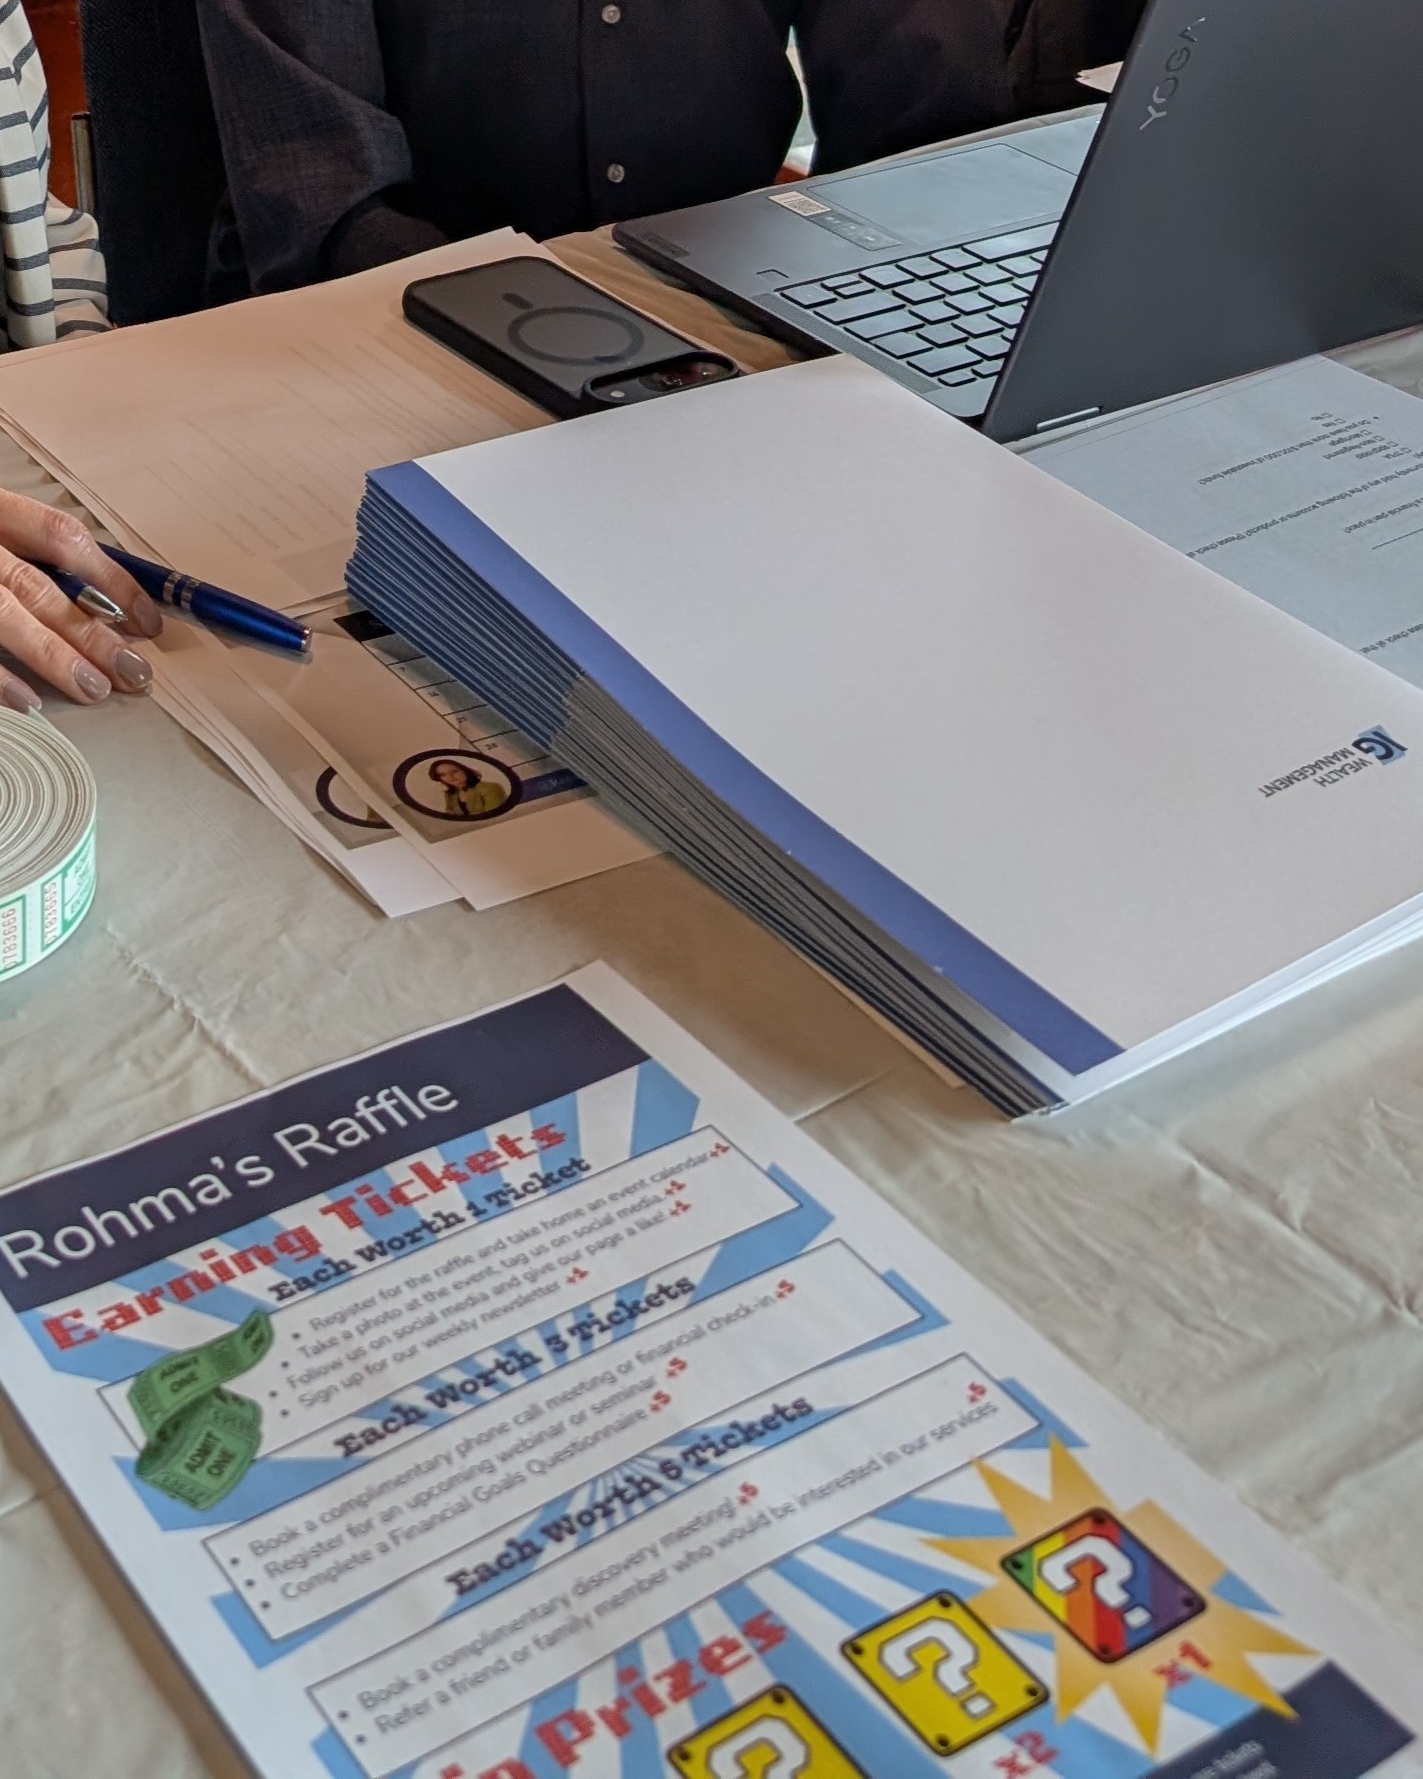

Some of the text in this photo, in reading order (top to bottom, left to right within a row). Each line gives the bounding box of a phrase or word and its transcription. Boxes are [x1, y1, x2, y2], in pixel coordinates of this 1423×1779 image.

[1351, 730, 1408, 761] IG
[1257, 747, 1356, 799] MANAGEMENT
[1313, 757, 1374, 787] WEALTH
[274, 1083, 459, 1167] Raffle
[42, 1122, 567, 1351] Earning Tickets
[534, 1610, 790, 1767] Prizes
[1153, 1639, 1214, 1689] x1
